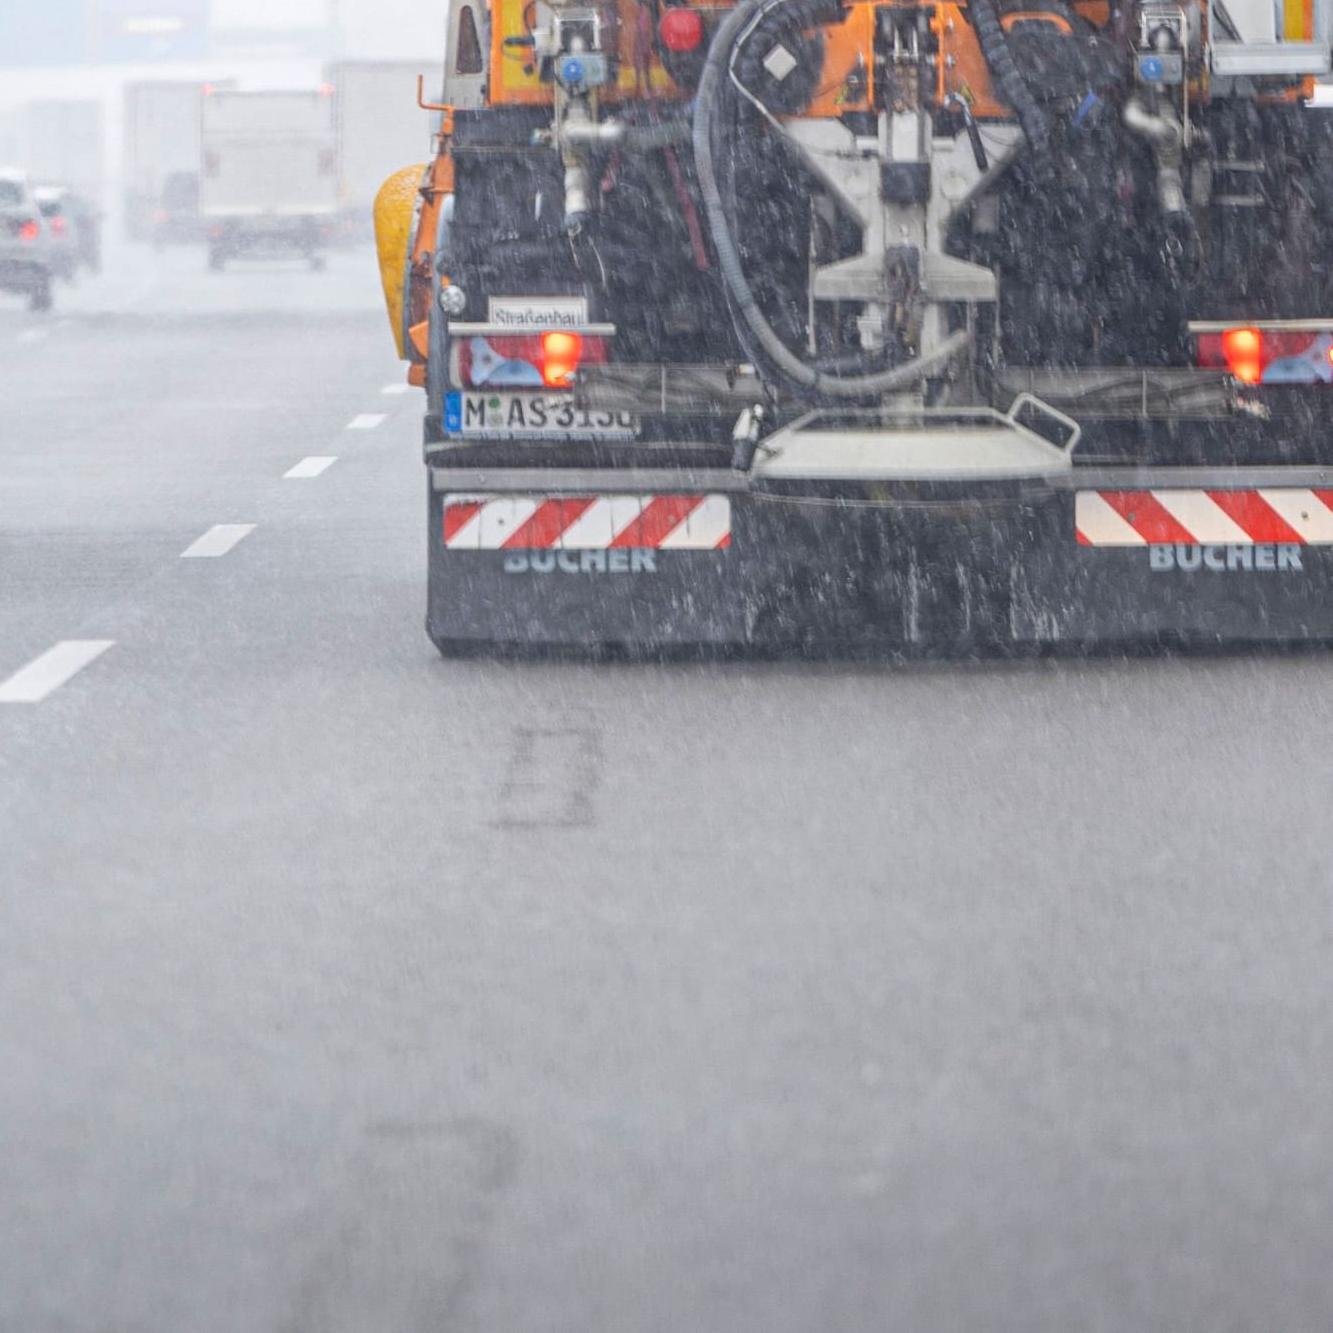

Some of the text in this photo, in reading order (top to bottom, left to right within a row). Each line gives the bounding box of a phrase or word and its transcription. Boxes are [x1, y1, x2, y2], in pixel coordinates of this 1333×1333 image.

[466, 397, 486, 427] M
[507, 397, 547, 427] AS
[503, 548, 658, 573] BUCHER
[1149, 542, 1304, 571] BUCHER
